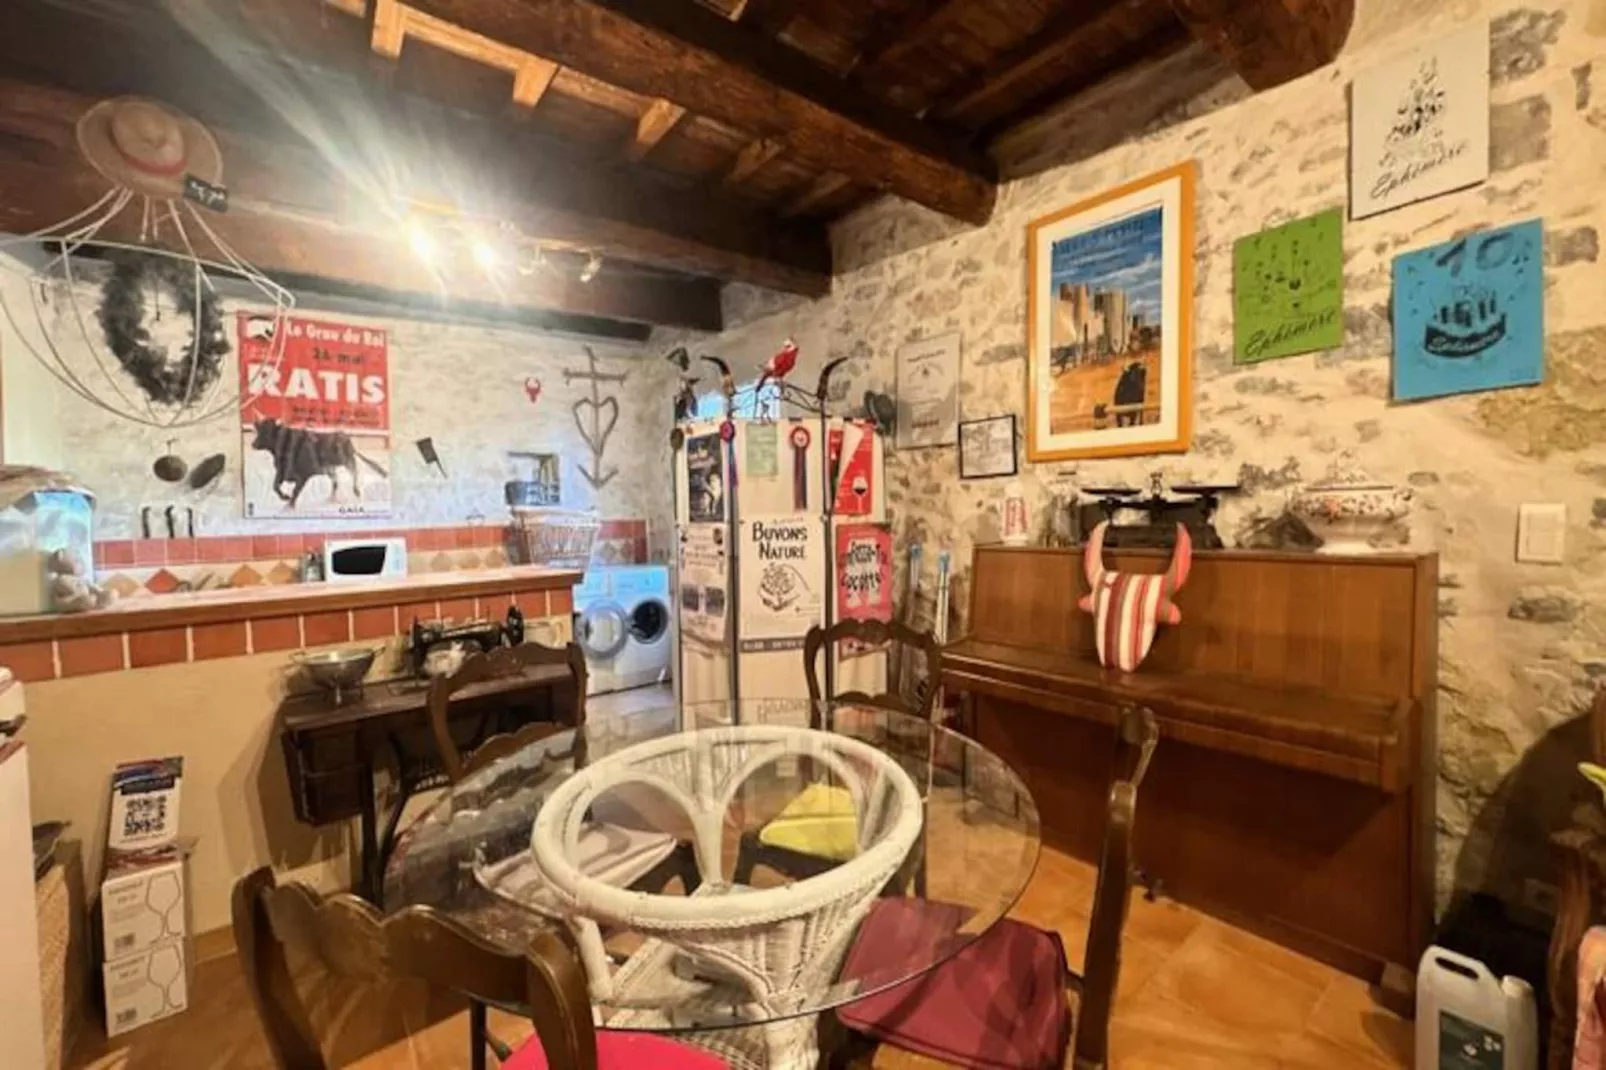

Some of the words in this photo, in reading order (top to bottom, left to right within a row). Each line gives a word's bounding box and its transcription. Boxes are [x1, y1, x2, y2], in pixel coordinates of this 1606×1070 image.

[306, 323, 339, 341] Grau
[343, 327, 360, 345] du
[363, 330, 385, 348] Roi
[247, 364, 386, 405] RATIS
